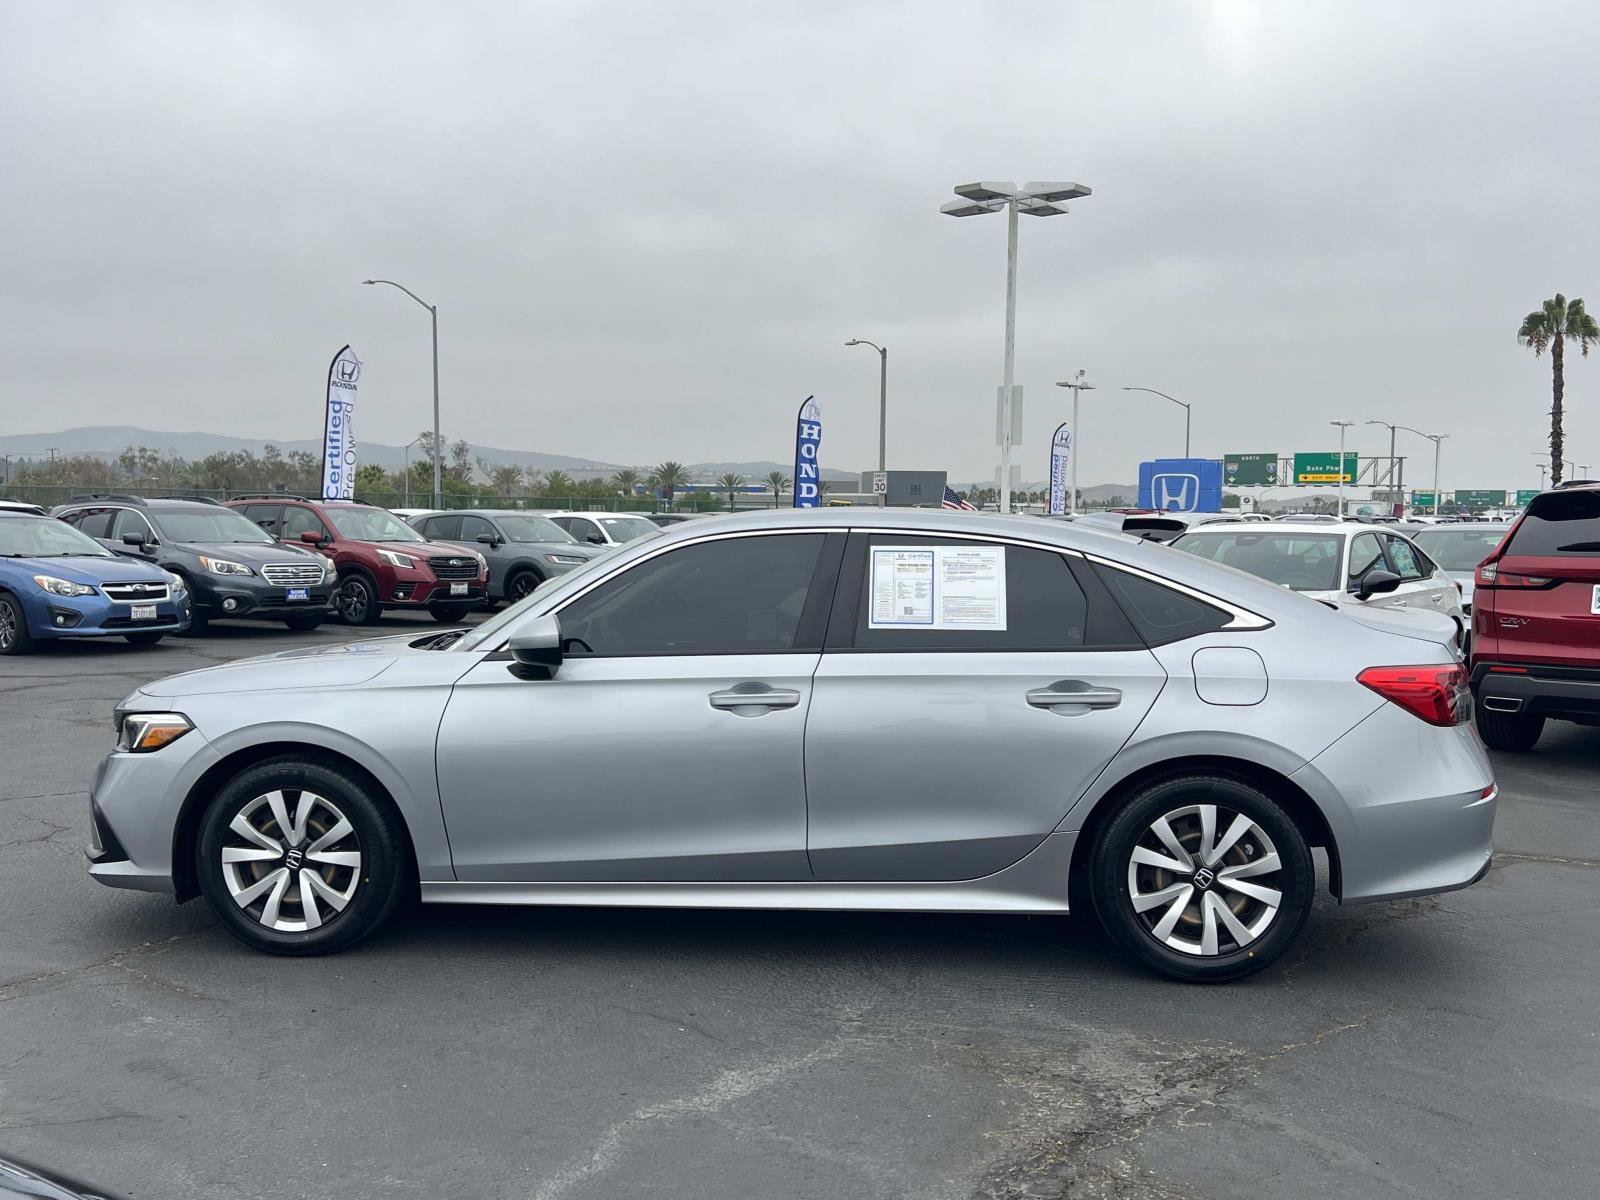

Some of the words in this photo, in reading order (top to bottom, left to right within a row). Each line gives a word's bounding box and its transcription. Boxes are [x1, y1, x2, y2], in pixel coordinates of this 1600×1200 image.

[332, 380, 357, 391] HONDA
[326, 400, 343, 498] Certified
[342, 402, 357, 499] Pre-Owned
[874, 483, 886, 491] 30
[1499, 617, 1530, 625] CR-V
